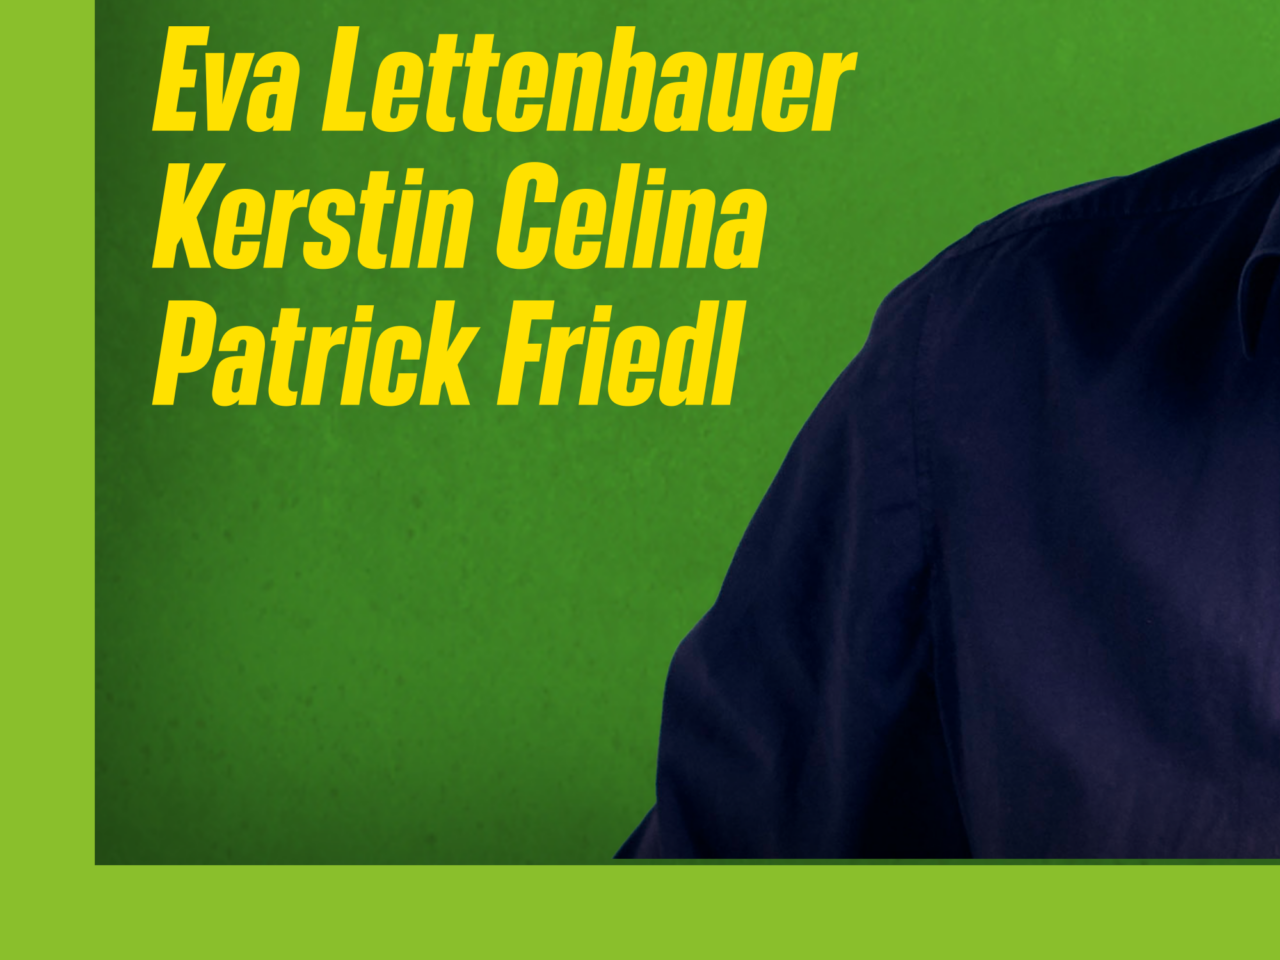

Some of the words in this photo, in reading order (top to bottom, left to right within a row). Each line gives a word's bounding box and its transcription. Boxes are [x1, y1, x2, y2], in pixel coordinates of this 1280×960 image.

[152, 25, 300, 133] Eva
[321, 25, 859, 133] Lettenbauer
[152, 163, 474, 270] Kerstin
[496, 161, 768, 270] Celina
[152, 300, 480, 407] Patrick
[496, 300, 747, 407] Friedl
